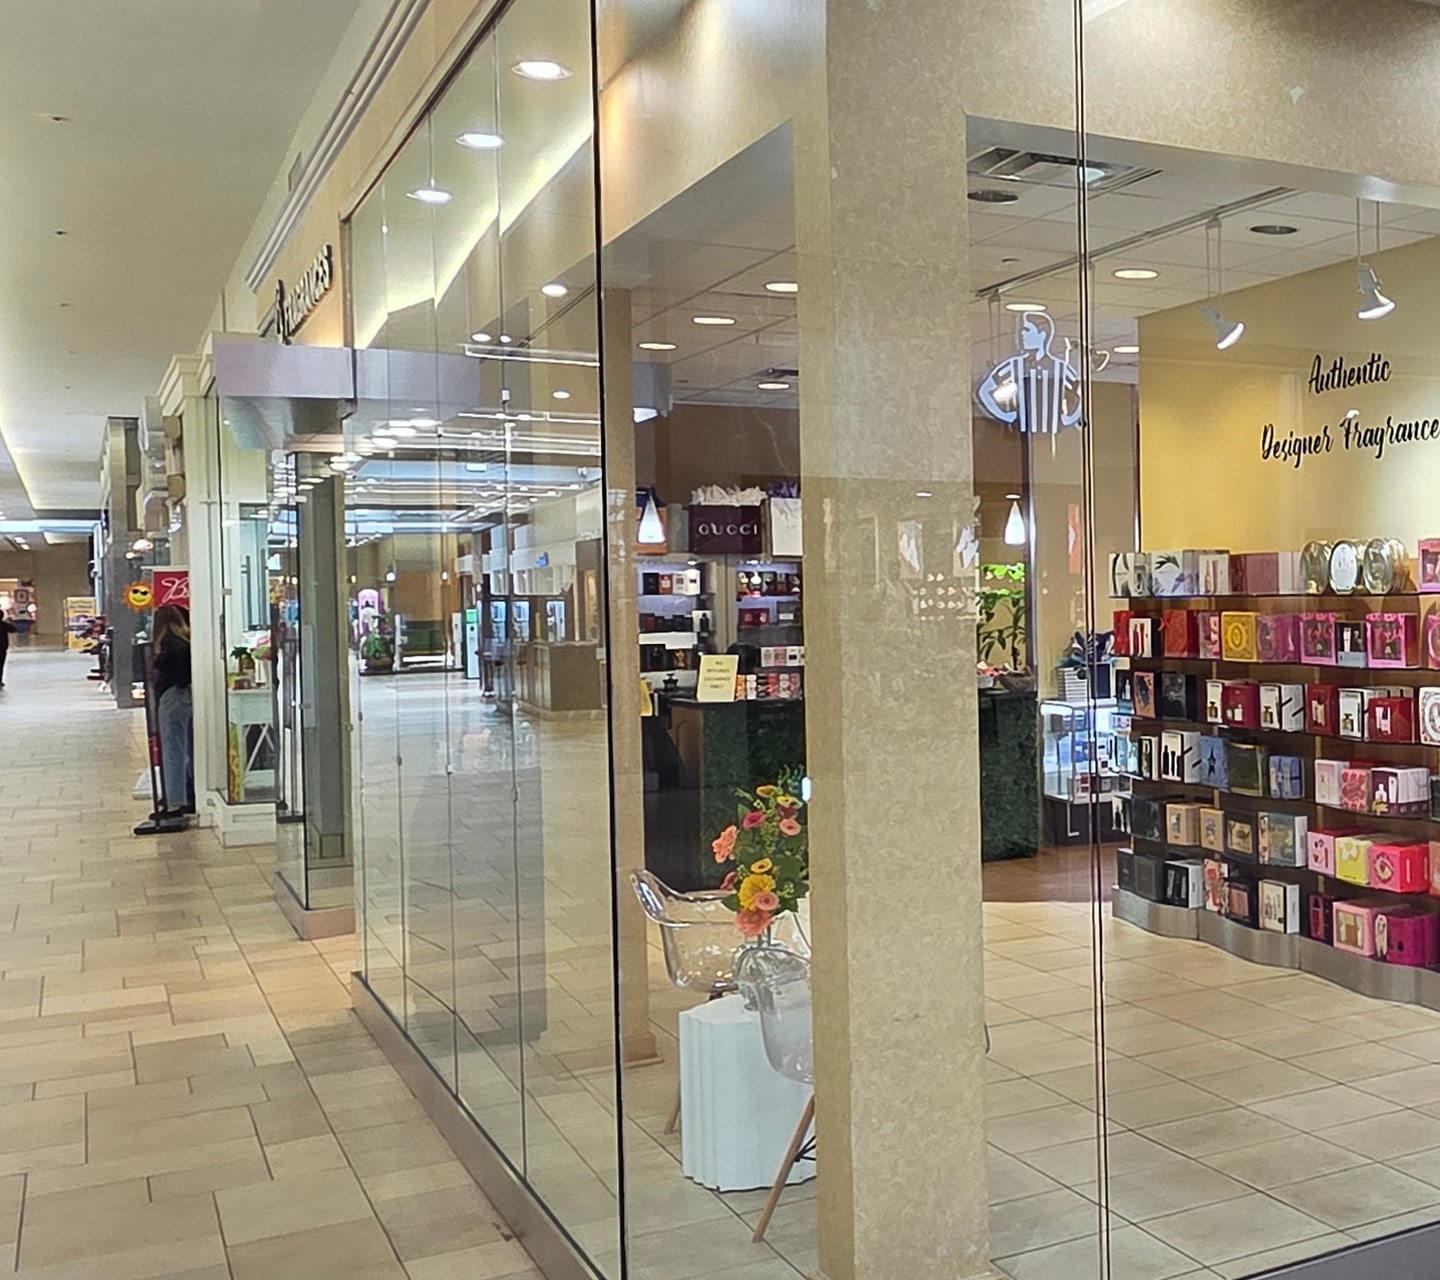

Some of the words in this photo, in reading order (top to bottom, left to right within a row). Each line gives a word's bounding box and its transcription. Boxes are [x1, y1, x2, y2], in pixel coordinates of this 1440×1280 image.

[1308, 353, 1391, 394] Authentic
[1261, 424, 1332, 468] Designer
[699, 523, 758, 536] GUCCI
